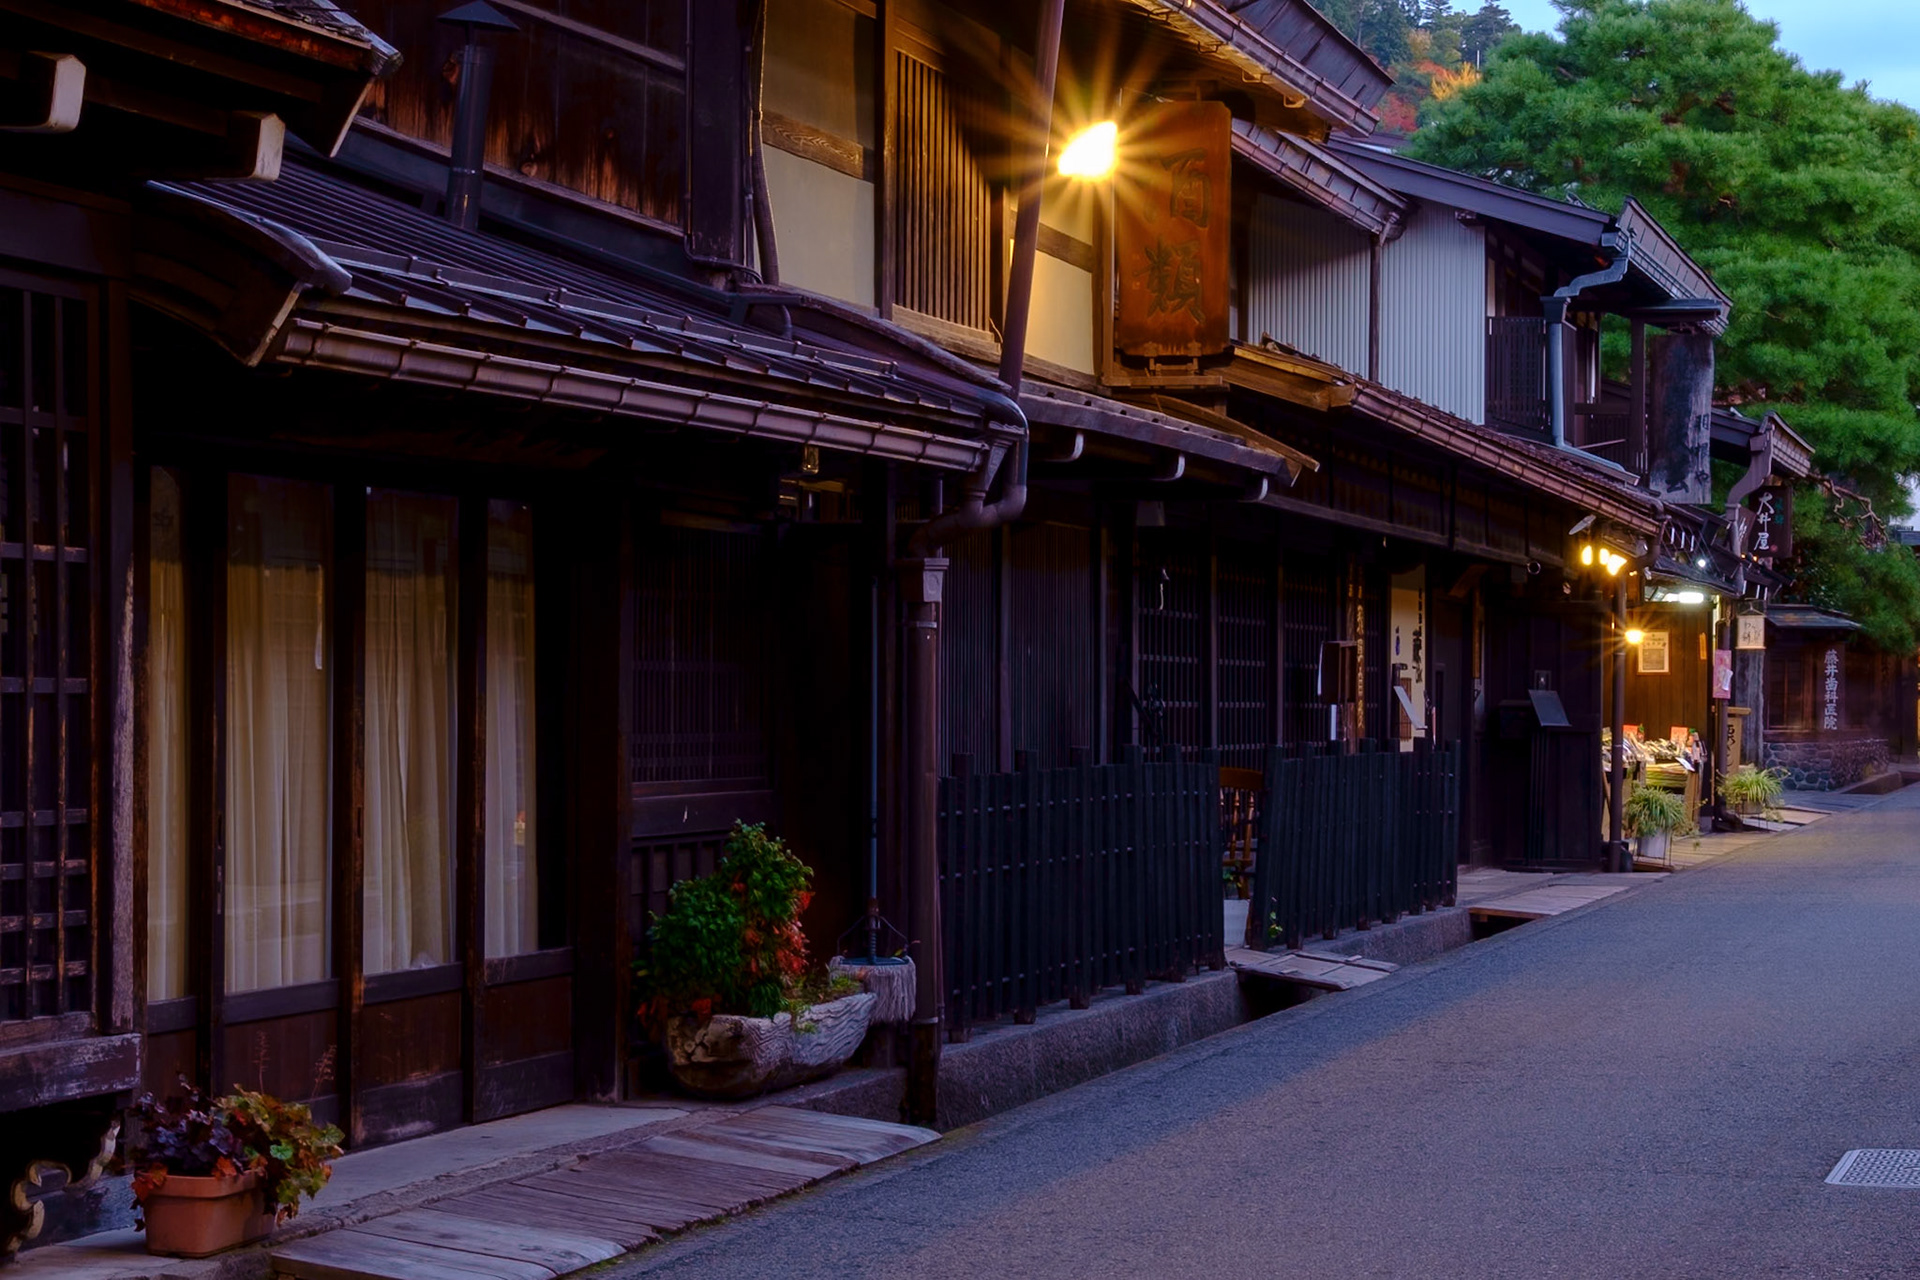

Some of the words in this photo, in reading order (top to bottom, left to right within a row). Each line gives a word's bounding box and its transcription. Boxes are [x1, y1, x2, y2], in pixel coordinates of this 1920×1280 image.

[1823, 648, 1840, 731] 藤井歯科医院
